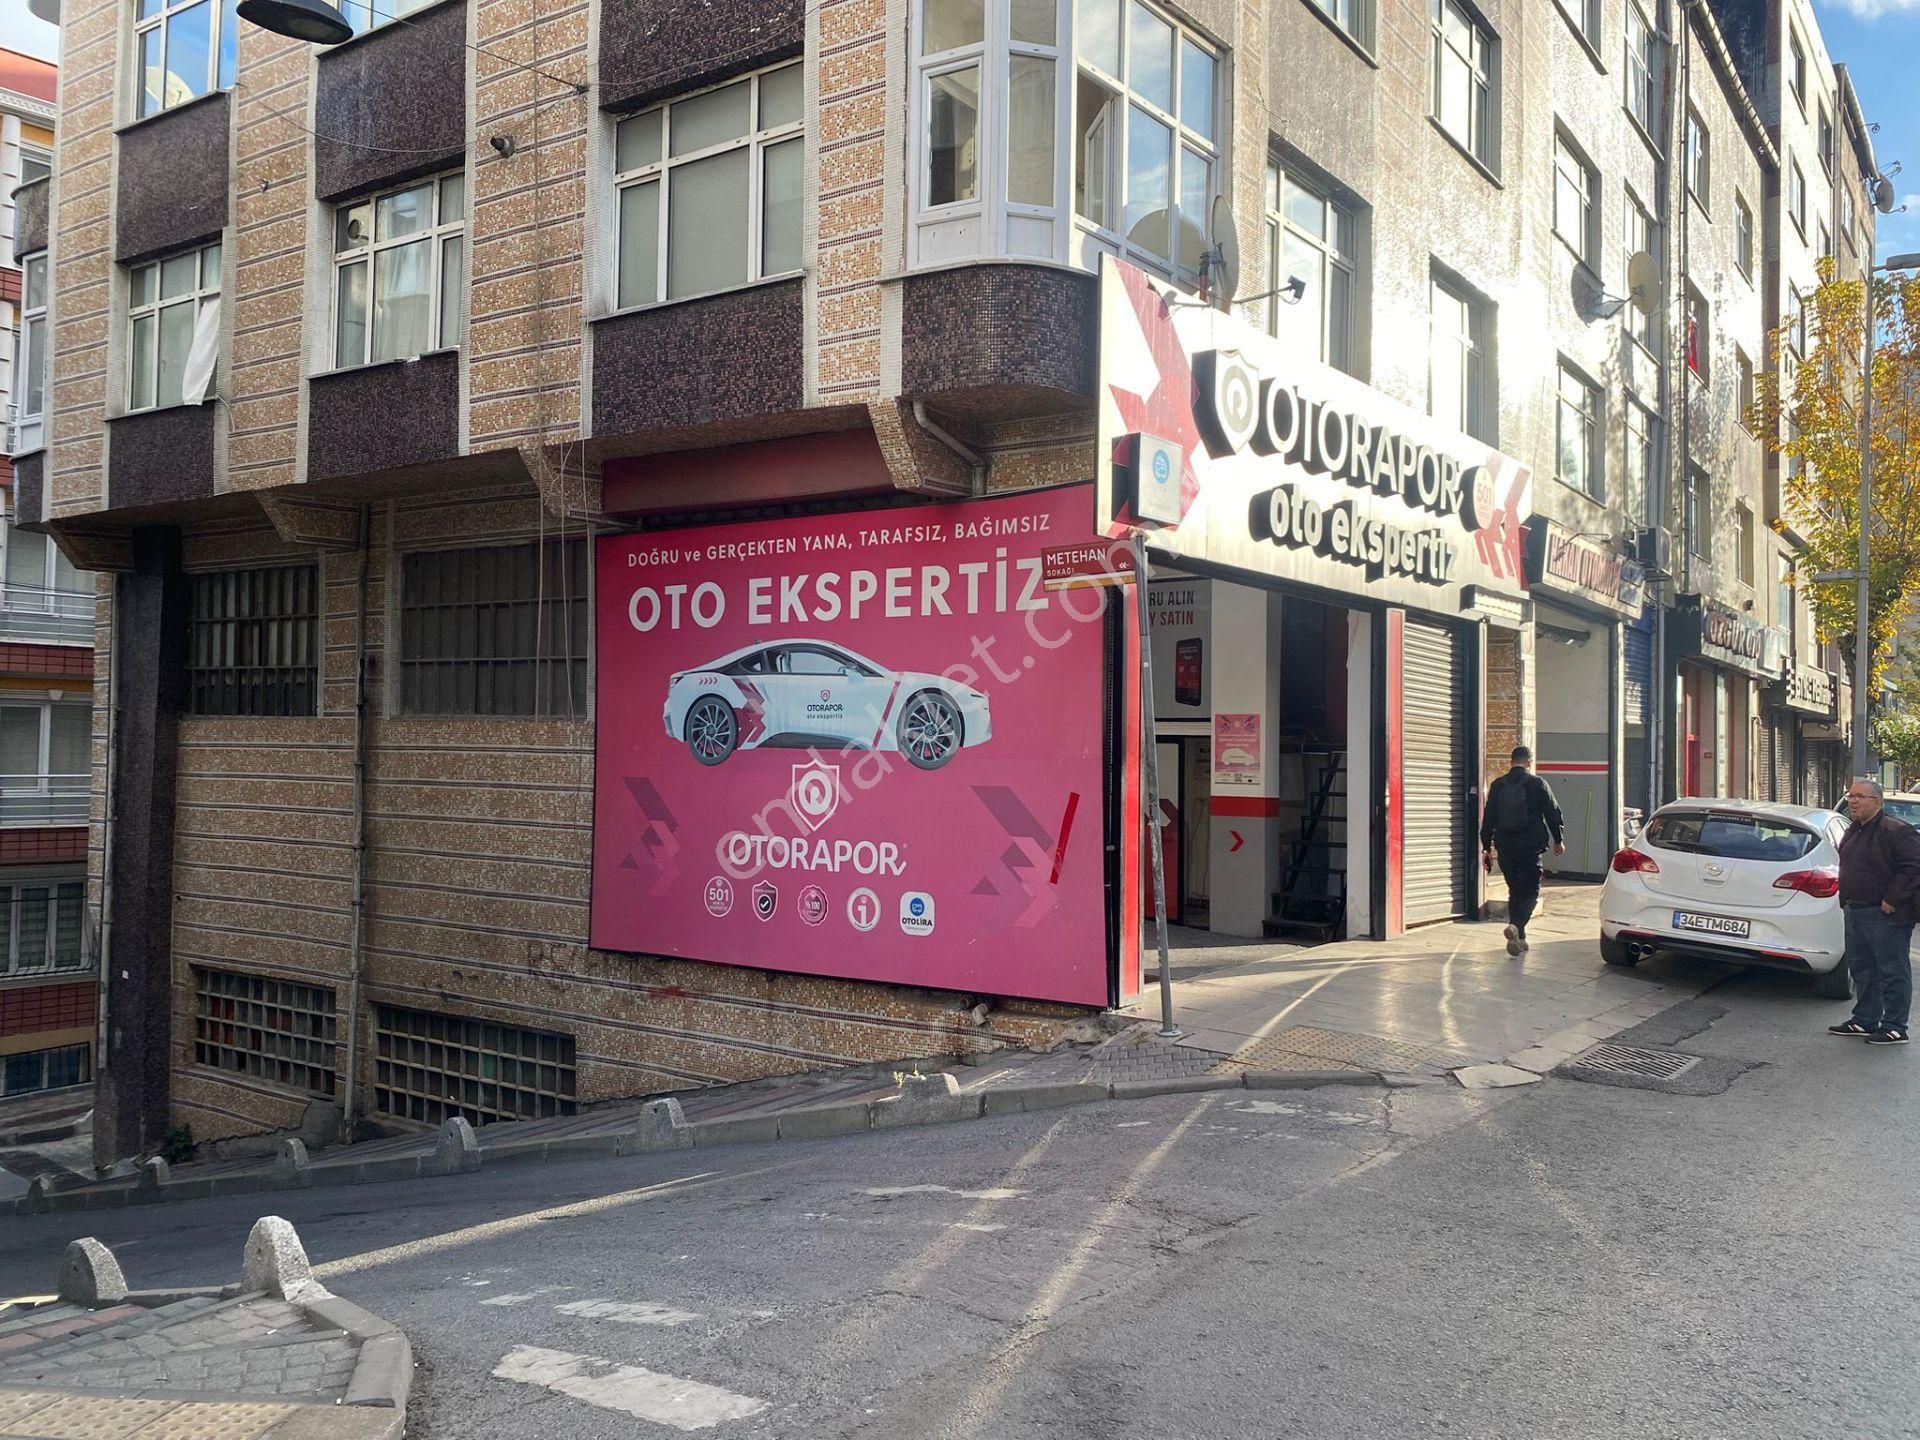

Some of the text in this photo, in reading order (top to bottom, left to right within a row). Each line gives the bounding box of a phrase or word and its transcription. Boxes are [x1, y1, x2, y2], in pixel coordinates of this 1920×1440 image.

[1264, 376, 1464, 514] OTORAPOR
[627, 513, 1051, 567] DOĞRU ve GERÇEKTEN YANA, TARAFSIZ, BAĞIMSIZ
[1269, 483, 1457, 580] oto ekspertiz
[1046, 548, 1106, 566] METEHAN
[628, 547, 1049, 633] OTO EKSPERTİZ
[1149, 590, 1194, 606] RU ALIN
[1149, 610, 1194, 626] Y SATIN
[806, 704, 844, 712] OTORAPOR
[728, 833, 908, 876] OTORAPOR
[708, 887, 729, 902] 501
[1680, 914, 1747, 934] 34ETM684
